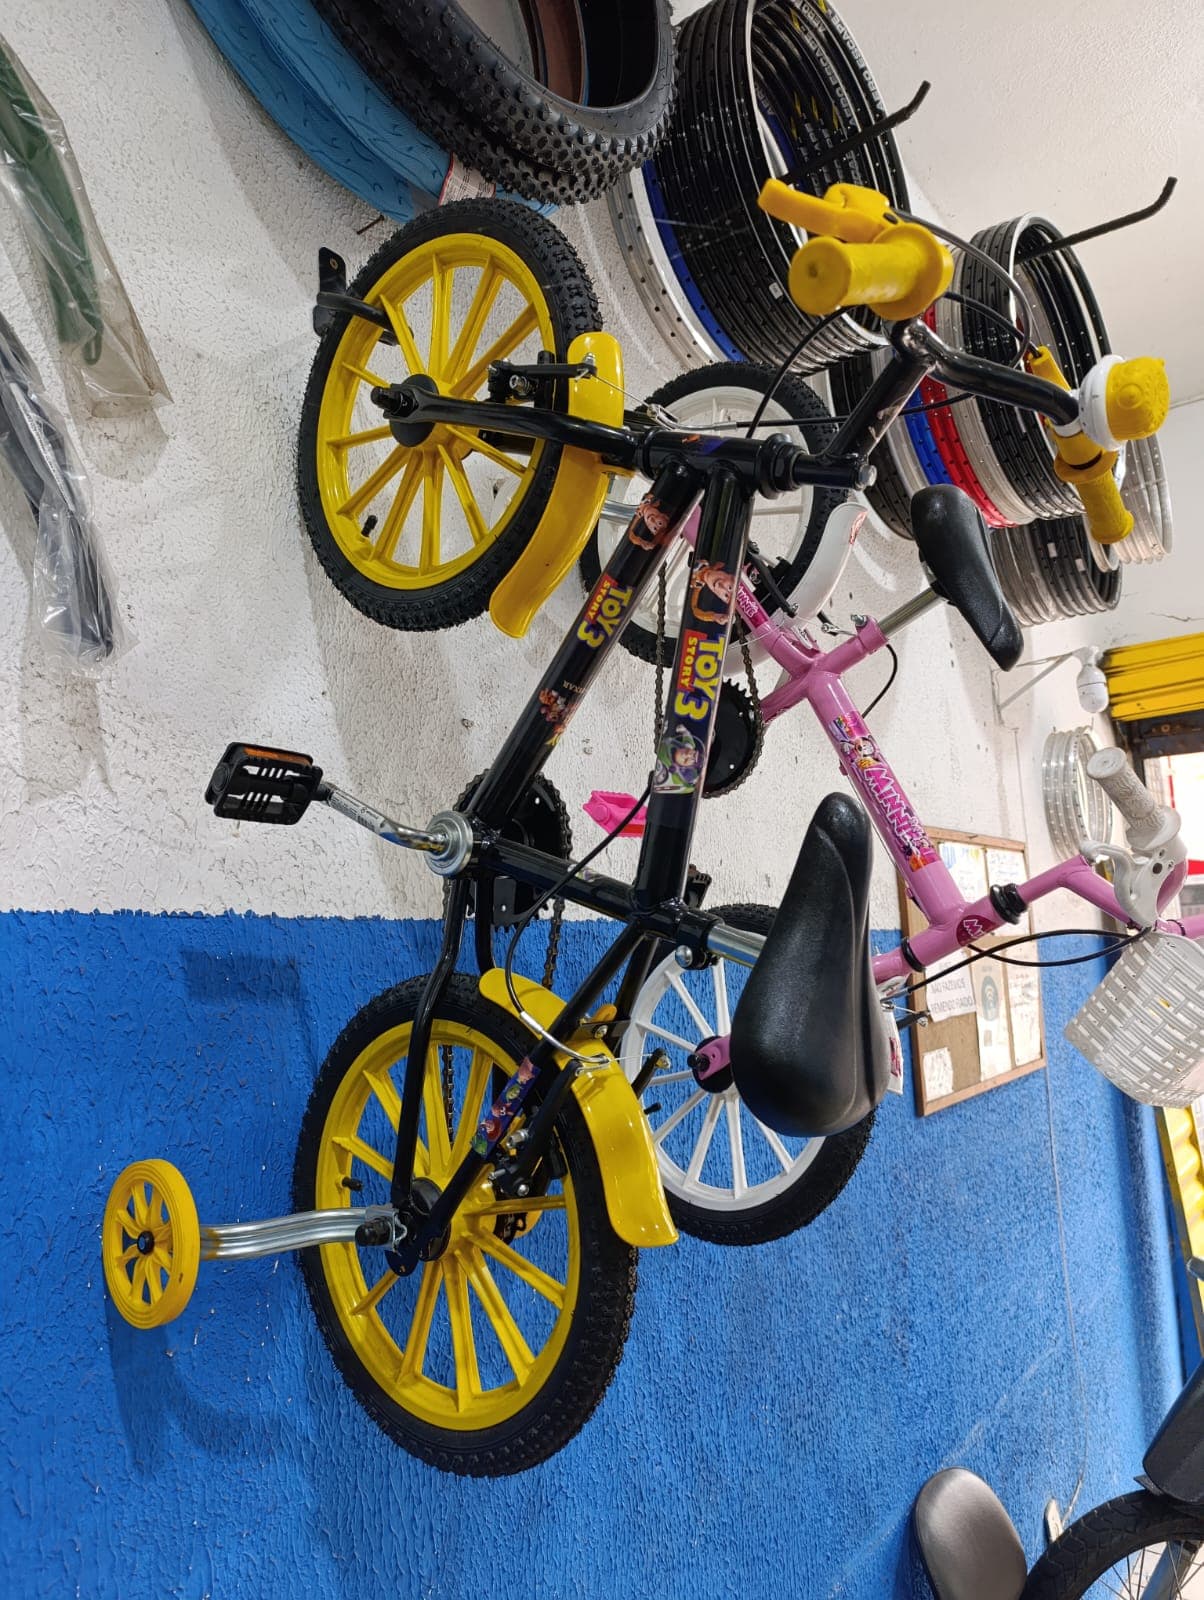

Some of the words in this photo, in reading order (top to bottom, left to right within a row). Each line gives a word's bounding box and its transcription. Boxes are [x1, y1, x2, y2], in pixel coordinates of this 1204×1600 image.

[830, 13, 866, 70] ESCAPE
[835, 86, 857, 127] AERO
[864, 70, 885, 113] AERO
[586, 579, 612, 620] STORY
[594, 585, 635, 635] TOY
[576, 622, 604, 649] 3
[679, 635, 699, 689] STORY
[693, 633, 725, 700] TOY
[673, 690, 709, 721] 3
